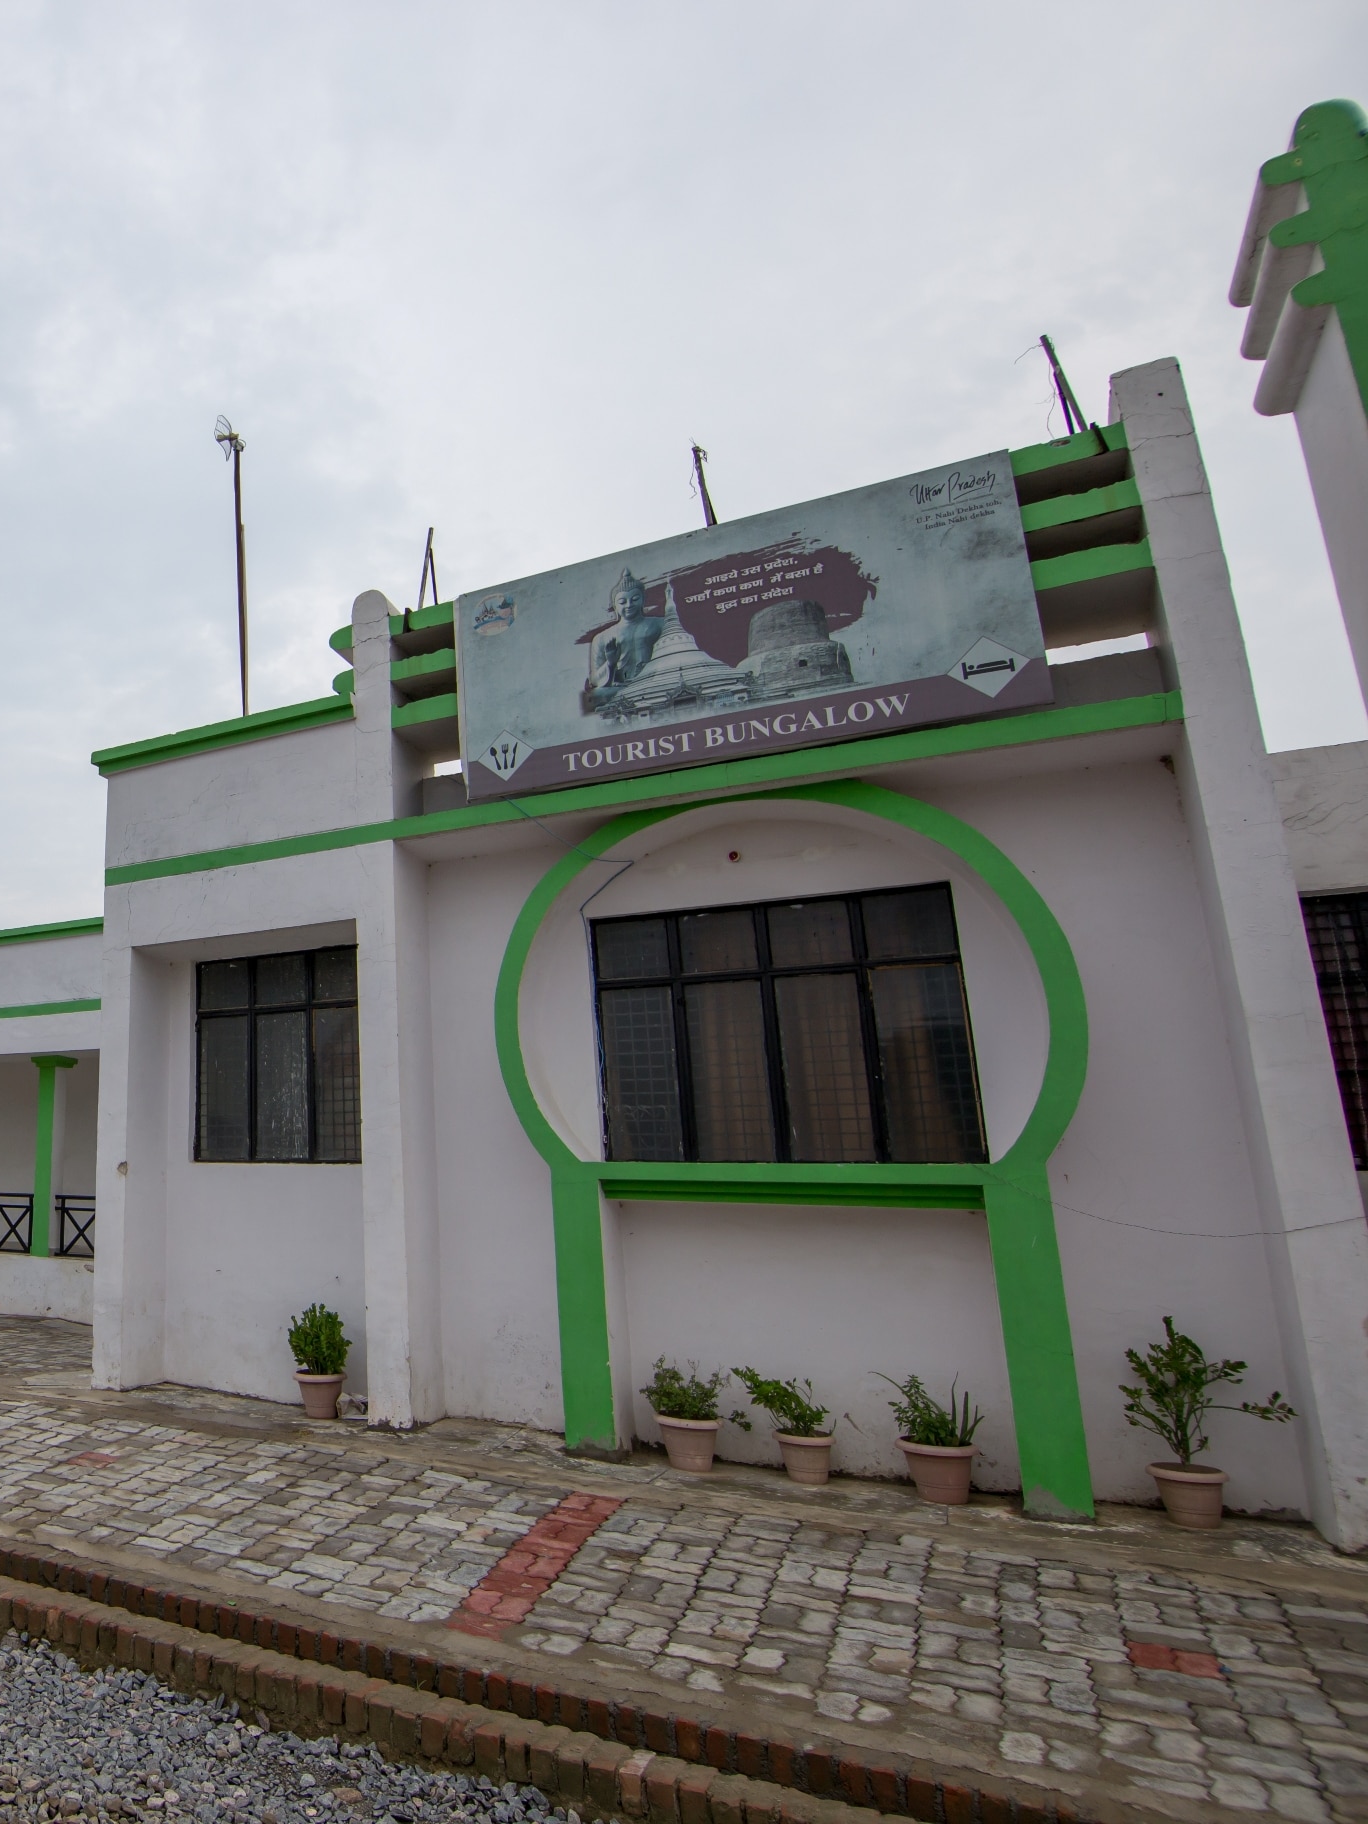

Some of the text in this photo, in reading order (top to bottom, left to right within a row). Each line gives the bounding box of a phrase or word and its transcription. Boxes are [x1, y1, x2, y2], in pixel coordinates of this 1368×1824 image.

[947, 470, 996, 503] Pradesh
[925, 509, 995, 530] India Nahi dekha
[935, 511, 955, 519] Nahi
[957, 504, 984, 514] Dekha
[704, 569, 738, 585] आइये
[740, 564, 761, 576] उस
[713, 585, 736, 597] कण
[739, 578, 763, 590] कण
[770, 571, 783, 583] में
[785, 567, 810, 579] बसा
[813, 562, 824, 575] है
[740, 594, 758, 604] का
[761, 586, 794, 600] संदेश
[562, 693, 911, 772] TOURIST BUNGALOW
